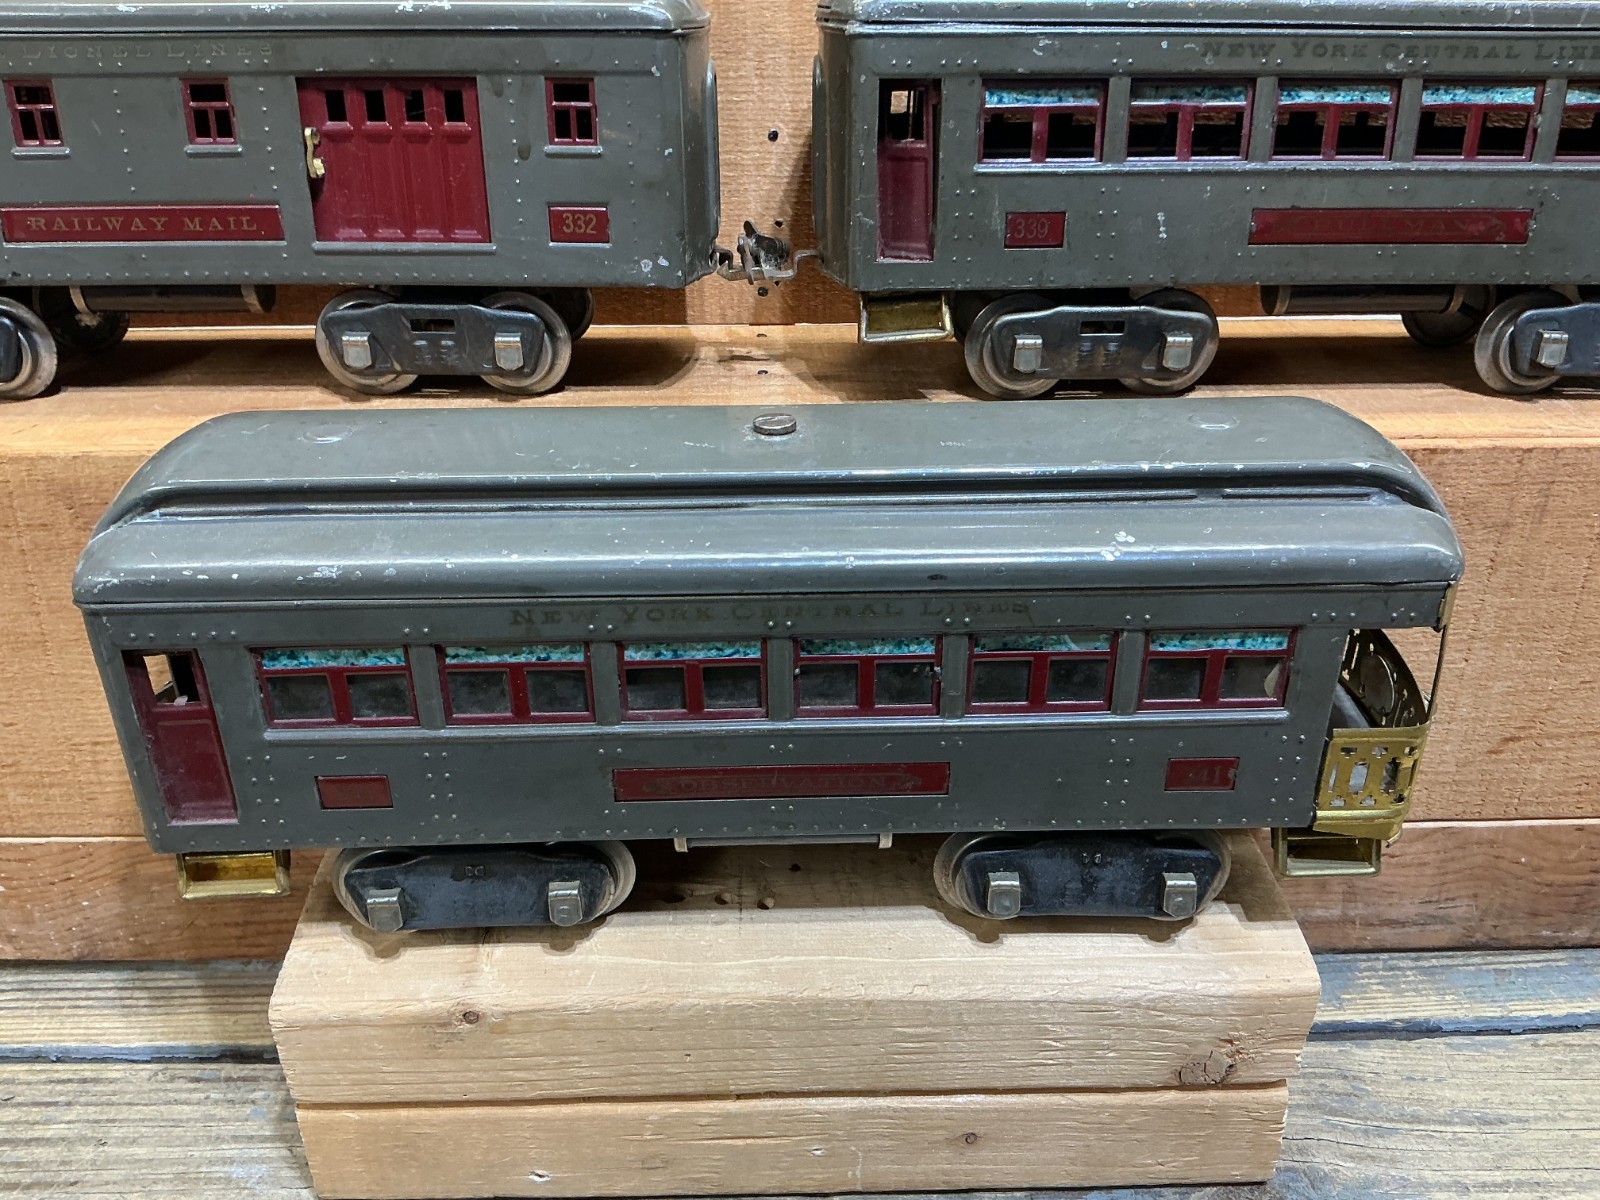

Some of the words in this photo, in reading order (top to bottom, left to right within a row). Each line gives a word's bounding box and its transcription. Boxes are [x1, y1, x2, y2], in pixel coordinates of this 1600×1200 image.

[22, 42, 151, 58] LIONEL
[167, 41, 273, 57] LINES
[1200, 41, 1276, 58] NEW
[1290, 41, 1368, 58] YORK
[1381, 42, 1521, 59] CENTRAL
[29, 216, 169, 231] RAILWAY
[183, 216, 258, 231] MAIL
[562, 212, 597, 234] 332
[1014, 218, 1049, 239] 339
[510, 608, 598, 625] NEW
[619, 606, 713, 624] YORK
